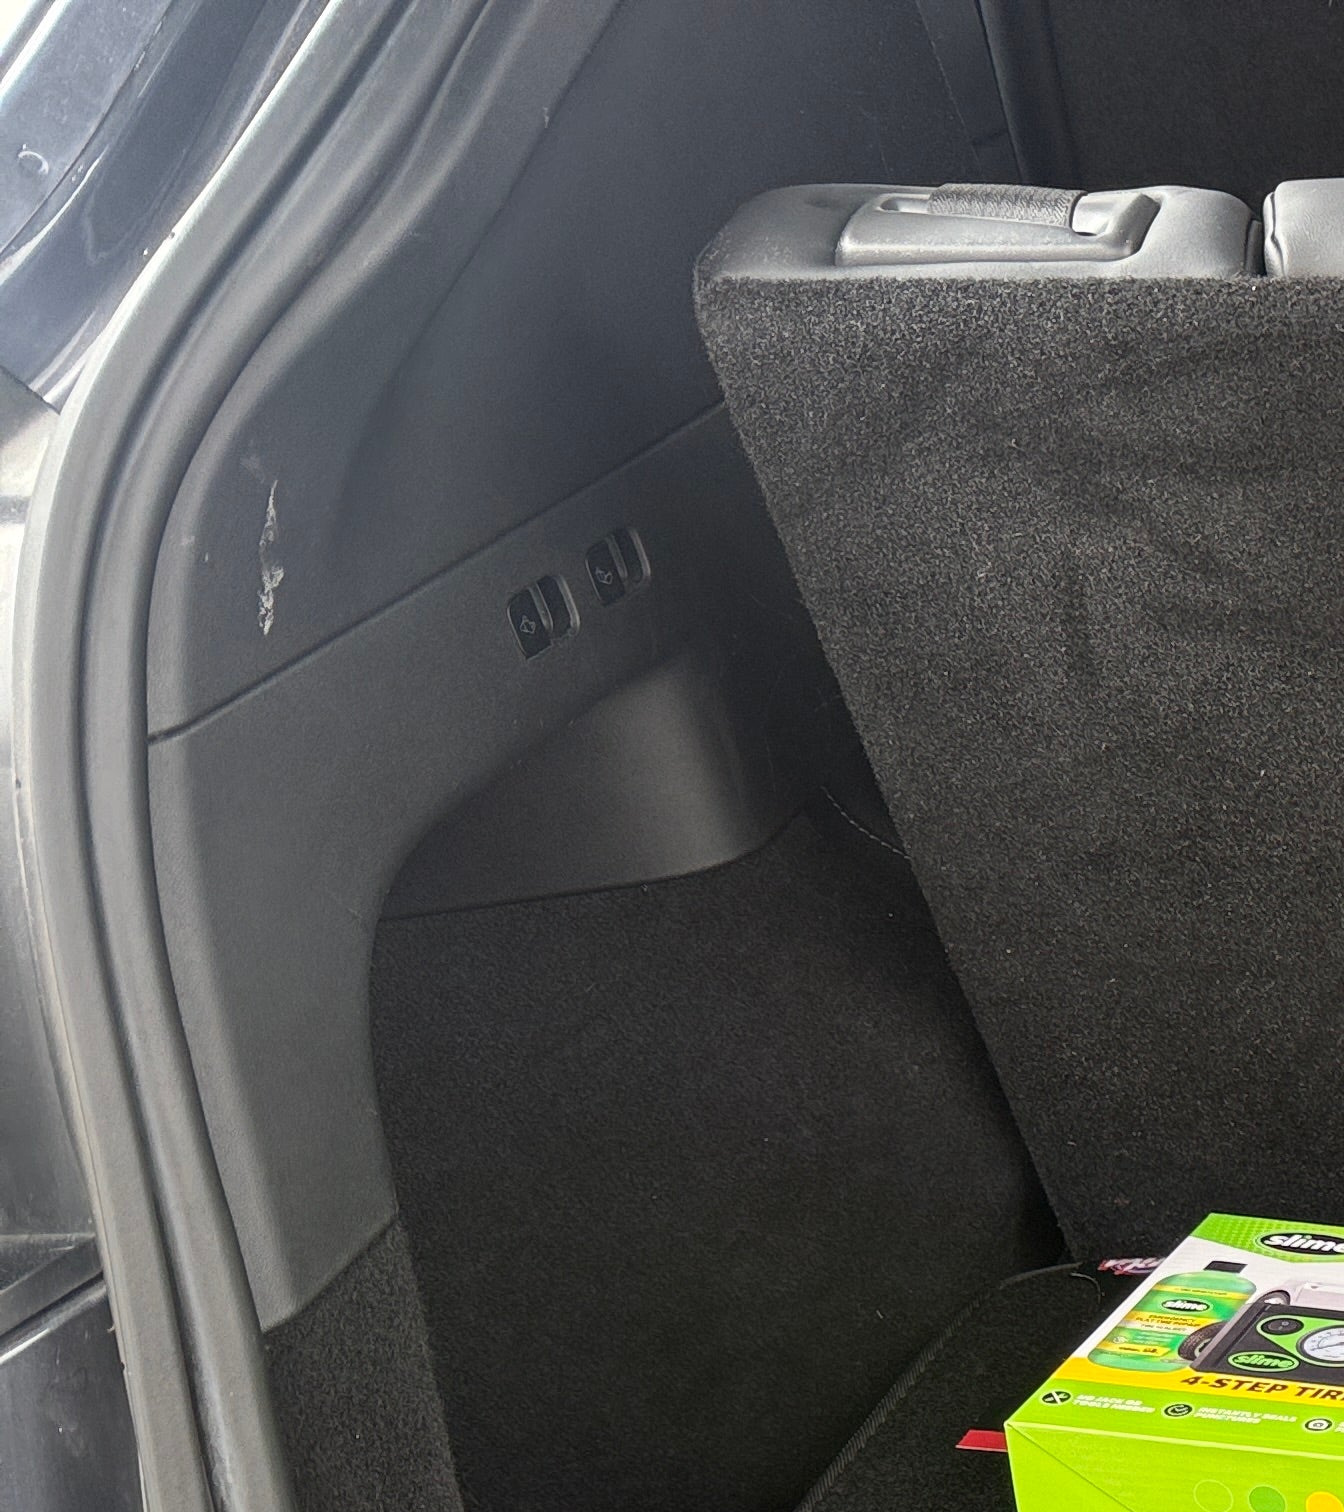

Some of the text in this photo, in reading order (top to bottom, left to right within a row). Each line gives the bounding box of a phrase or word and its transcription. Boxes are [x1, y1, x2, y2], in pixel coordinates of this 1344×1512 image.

[1162, 1300, 1208, 1311] slime
[1234, 1354, 1295, 1369] slime
[1180, 1376, 1289, 1394] 4-STEP
